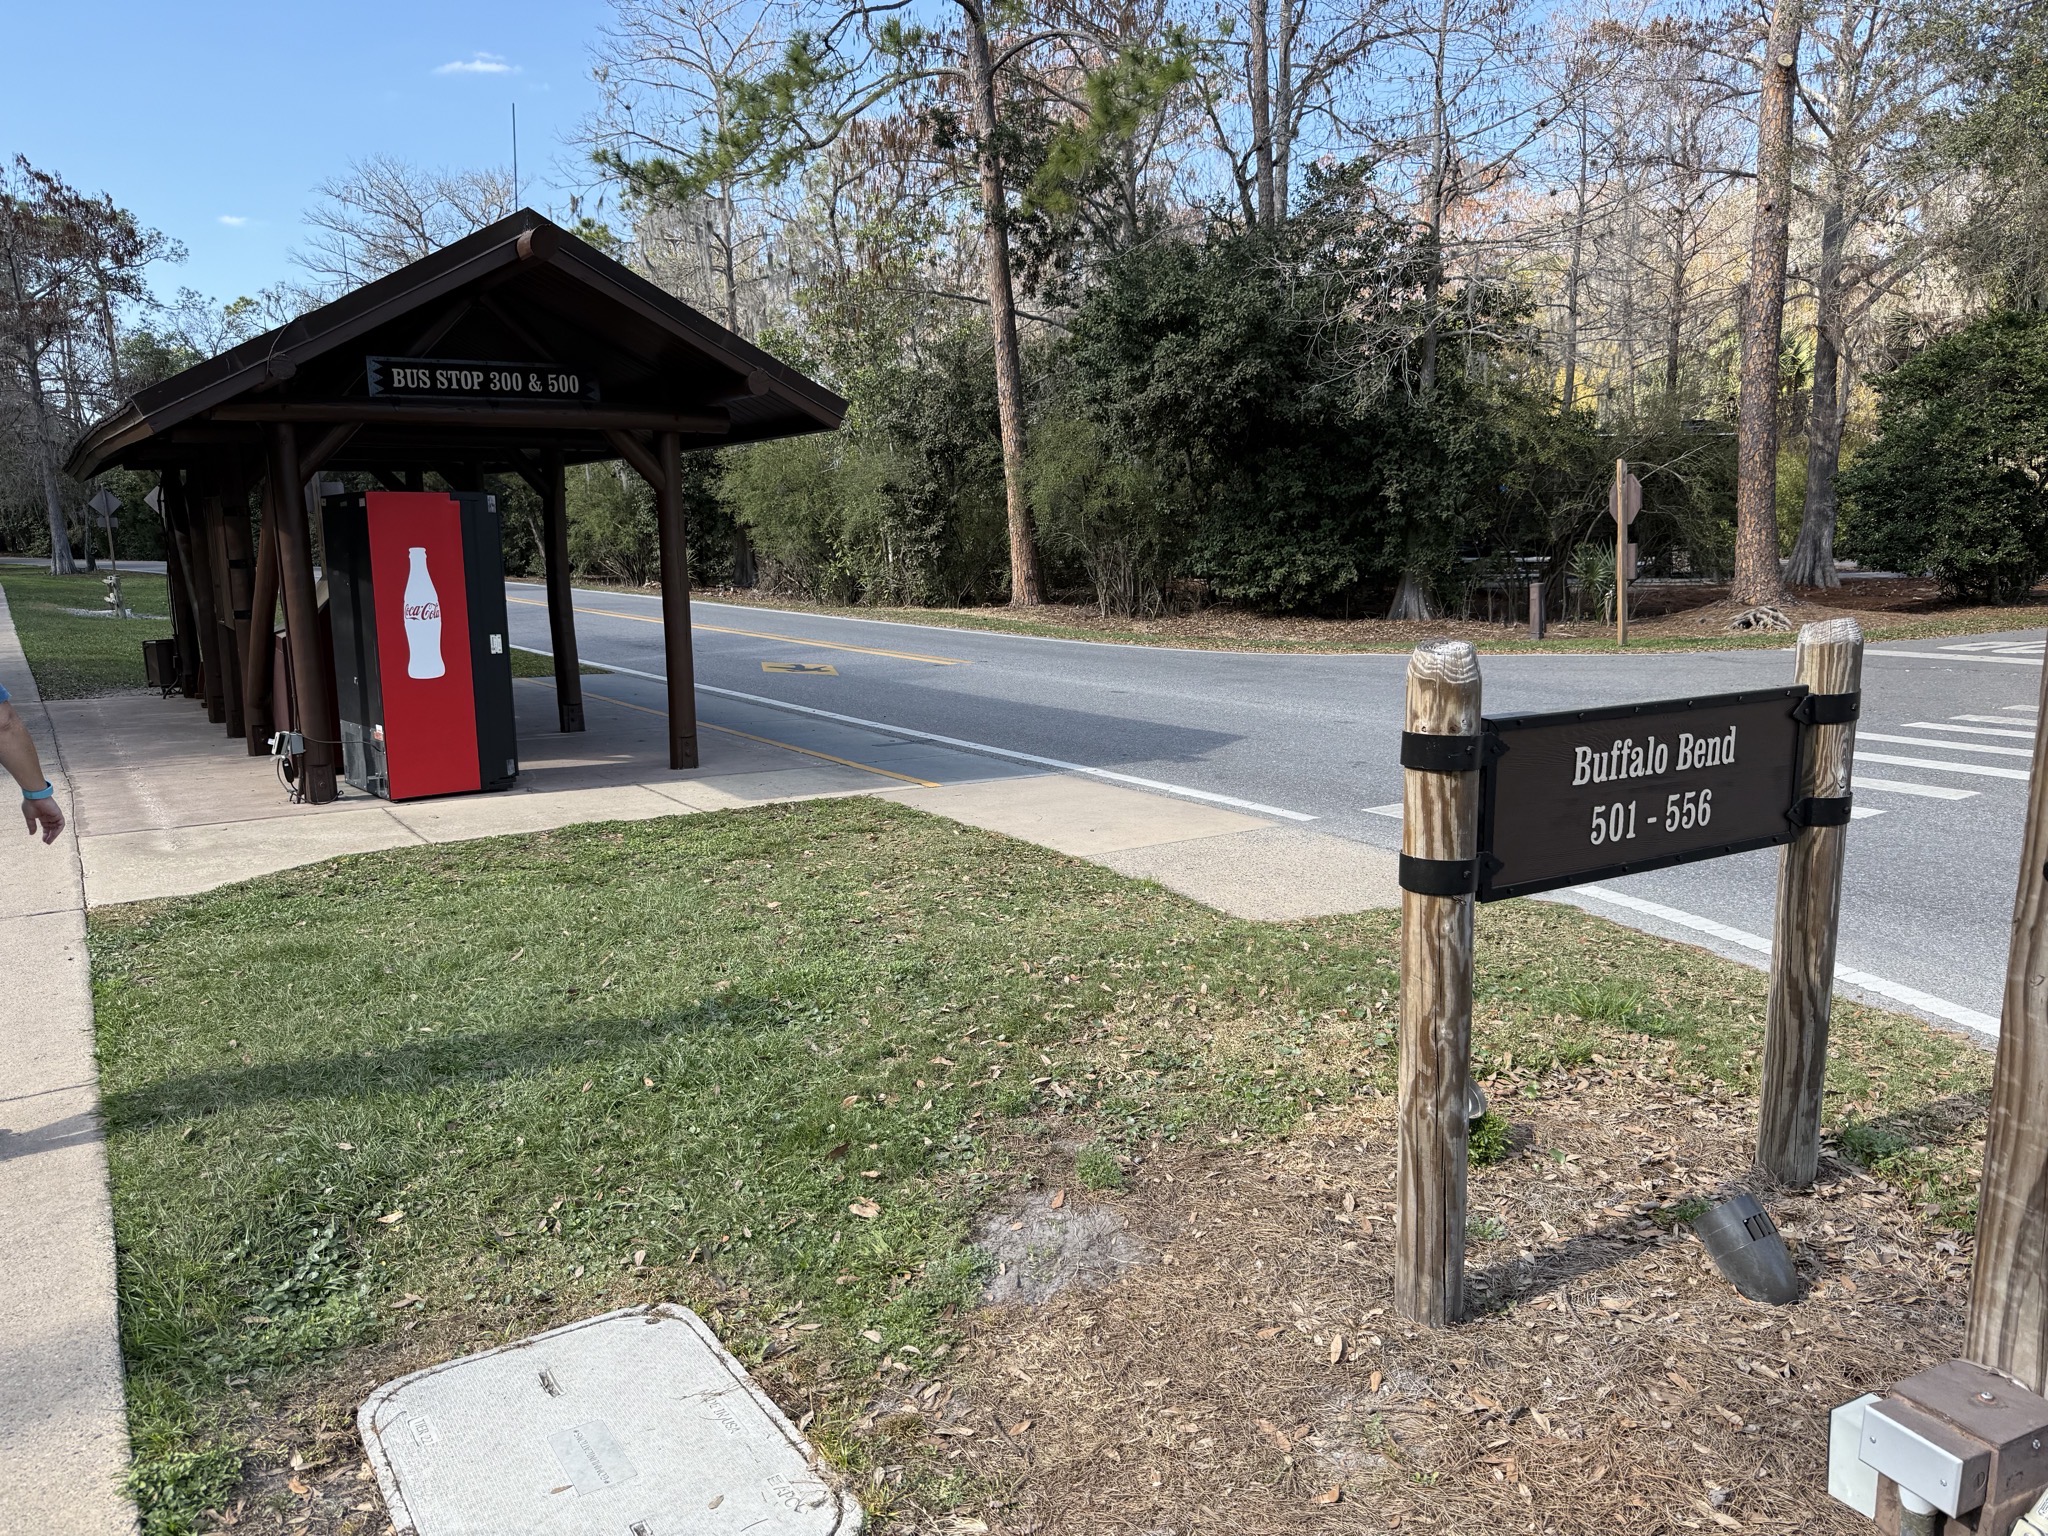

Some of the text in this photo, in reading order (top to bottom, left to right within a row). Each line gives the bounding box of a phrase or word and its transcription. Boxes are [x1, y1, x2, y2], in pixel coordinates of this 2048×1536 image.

[392, 368, 580, 394] BUS STOP 300 & 500
[1572, 725, 1737, 786] Buffalo Bend
[1590, 800, 1637, 846] 501
[1664, 788, 1713, 833] 556
[414, 1418, 433, 1445] TIER 22
[721, 1417, 740, 1434] USA
